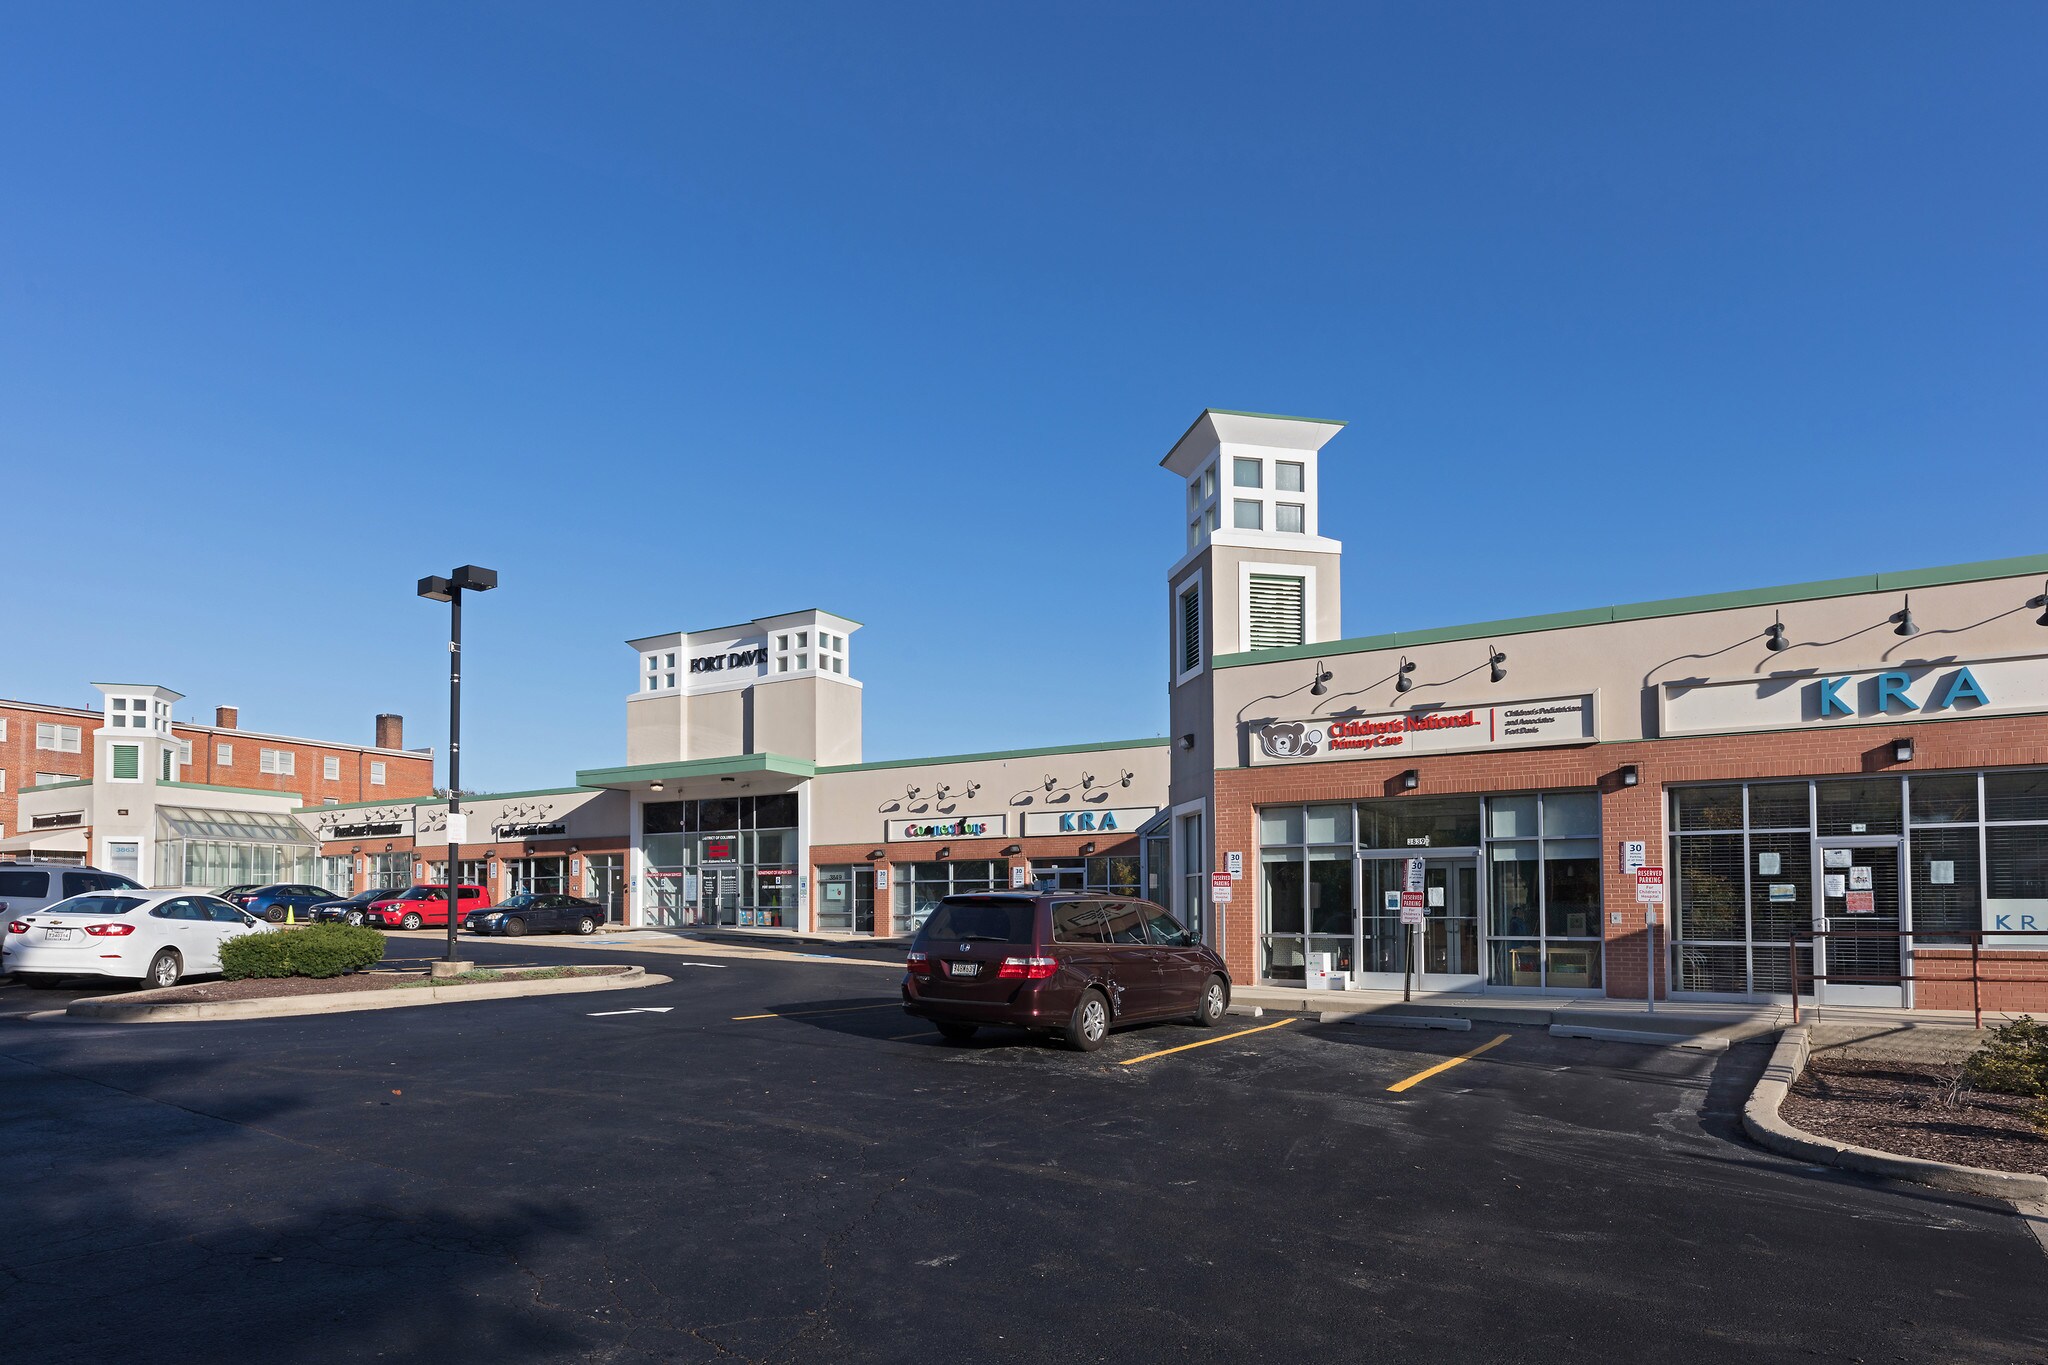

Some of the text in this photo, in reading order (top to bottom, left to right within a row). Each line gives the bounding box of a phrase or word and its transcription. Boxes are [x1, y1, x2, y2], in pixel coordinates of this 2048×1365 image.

[690, 648, 768, 673] FORT DAVIS
[1821, 667, 1990, 715] KRA
[1407, 710, 1474, 731] National
[1331, 735, 1403, 750] Primary Care
[1063, 811, 1118, 830] KRA
[1996, 914, 2048, 931] KR
